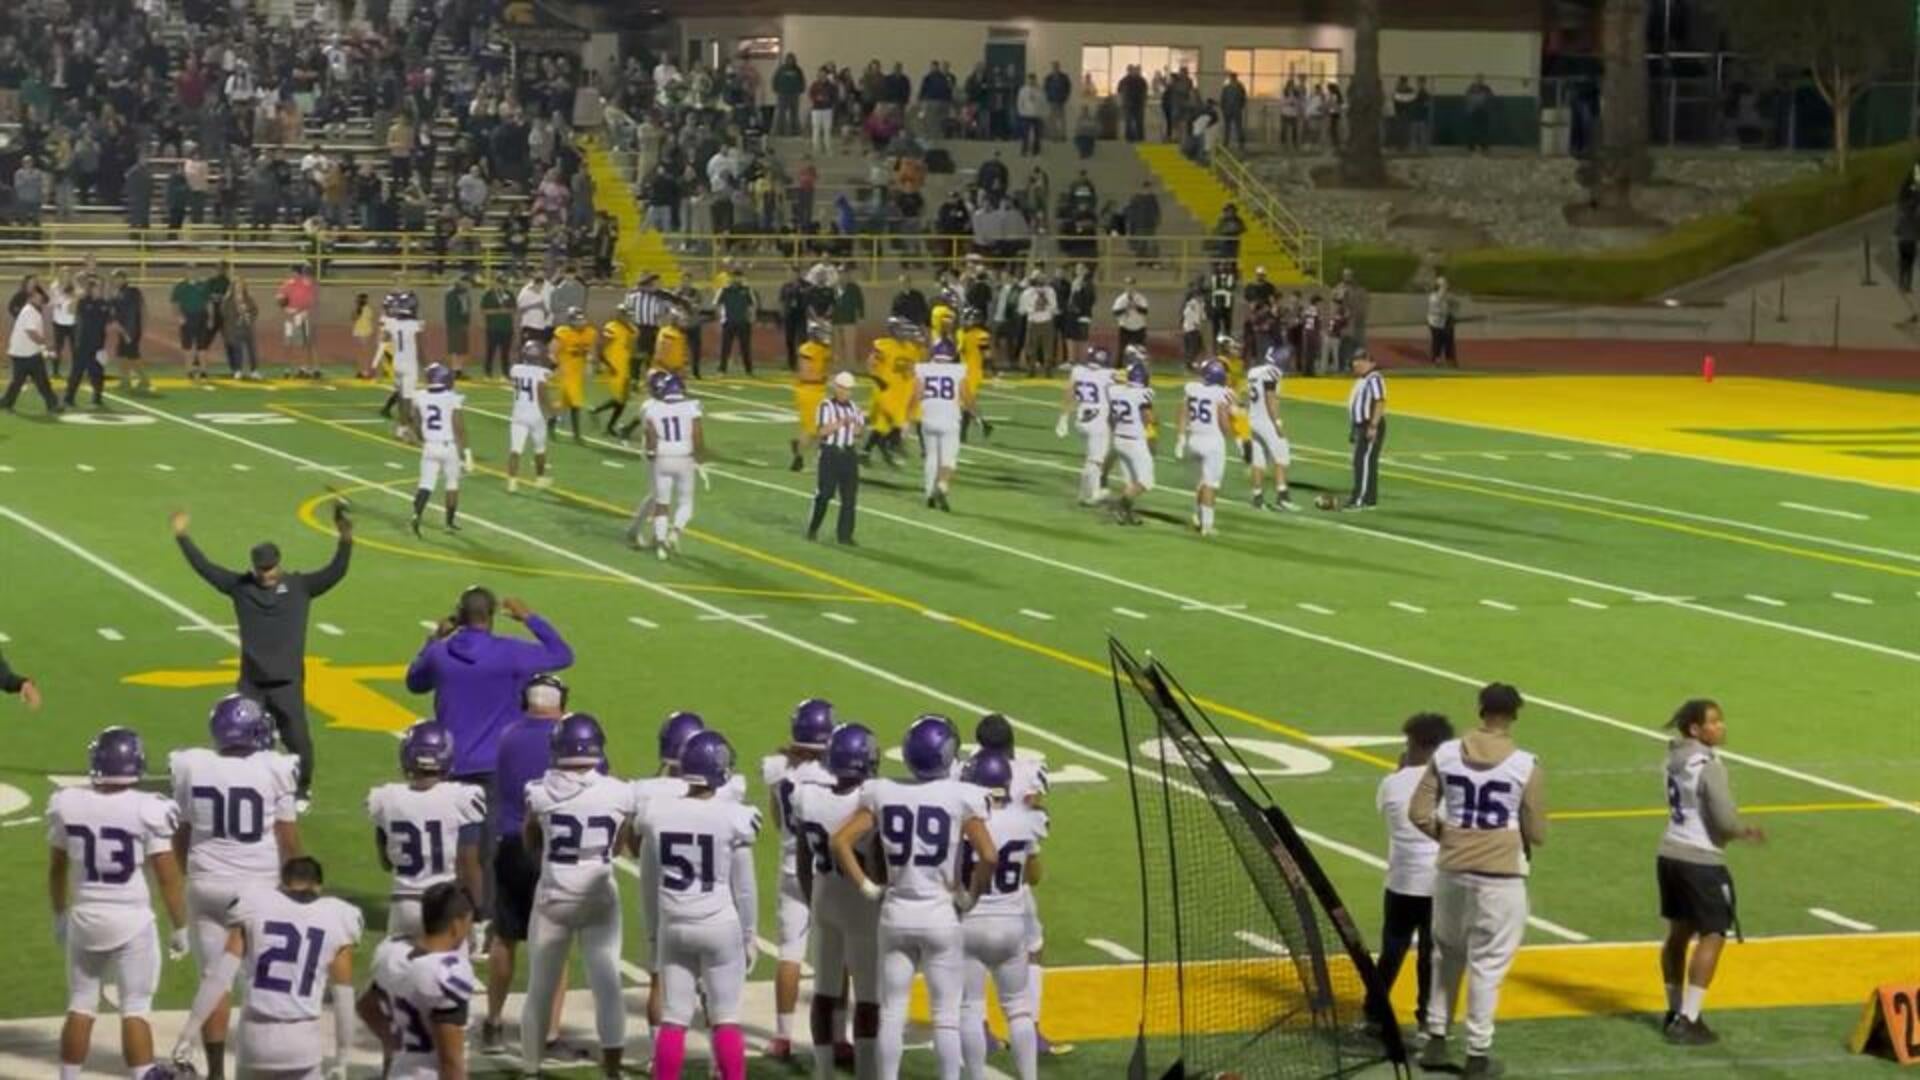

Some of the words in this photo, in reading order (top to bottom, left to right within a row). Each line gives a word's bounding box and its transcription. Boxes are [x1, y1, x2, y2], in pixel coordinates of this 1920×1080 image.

[427, 404, 443, 430] 2
[924, 376, 955, 401] 58
[661, 416, 682, 442] 11
[193, 785, 264, 844] 70
[1445, 774, 1513, 830] 76
[65, 824, 136, 885] 73
[391, 820, 445, 877] 31
[659, 832, 715, 892] 51
[883, 804, 951, 867] 99
[254, 920, 326, 998] 21
[1893, 990, 1920, 1058] 2
